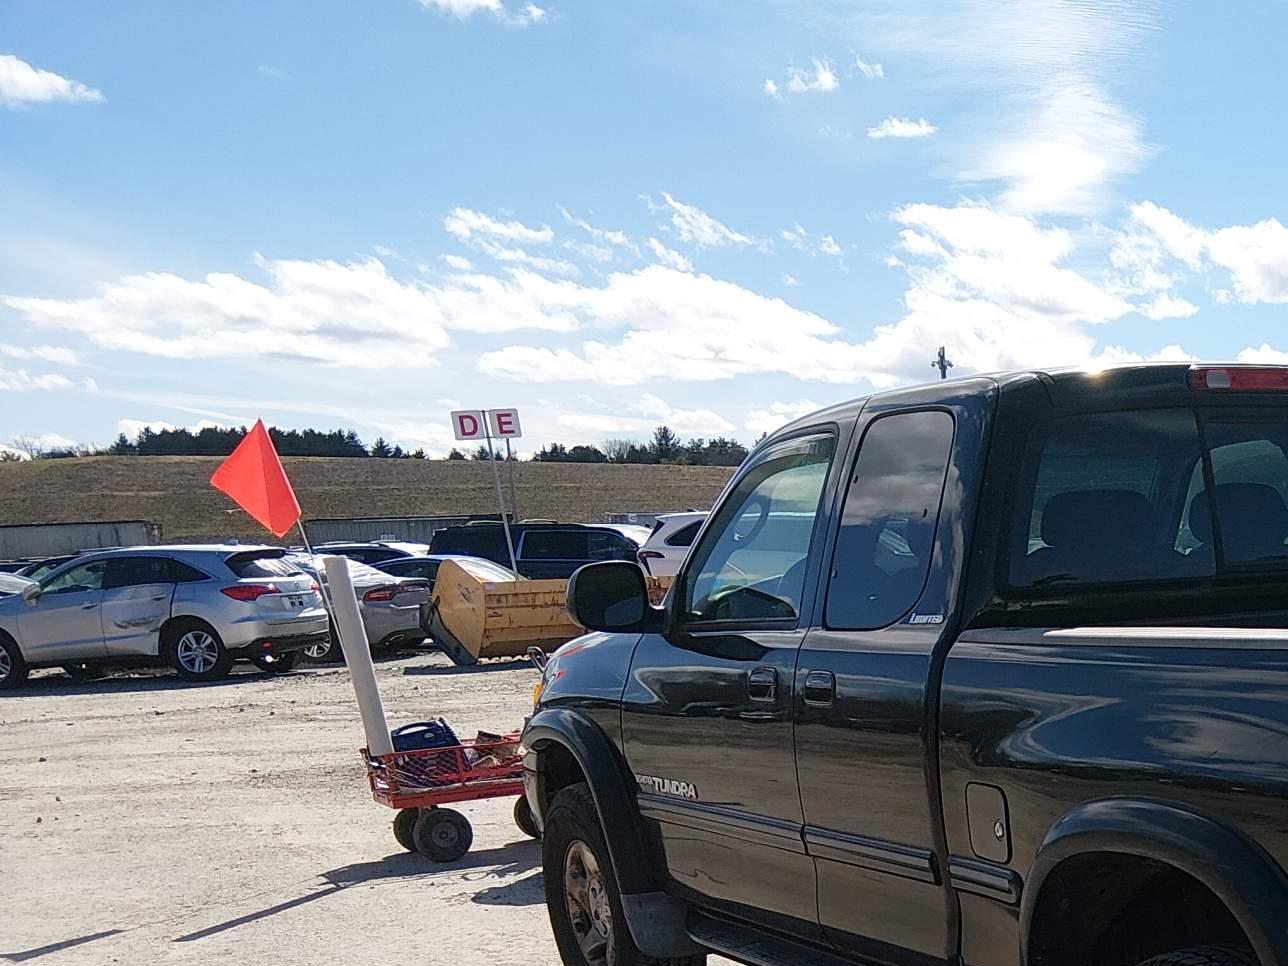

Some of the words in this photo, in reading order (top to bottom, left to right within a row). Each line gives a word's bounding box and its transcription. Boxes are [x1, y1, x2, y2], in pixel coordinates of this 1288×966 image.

[458, 414, 478, 436] D
[496, 413, 515, 434] E
[653, 777, 698, 799] TUNDRA
